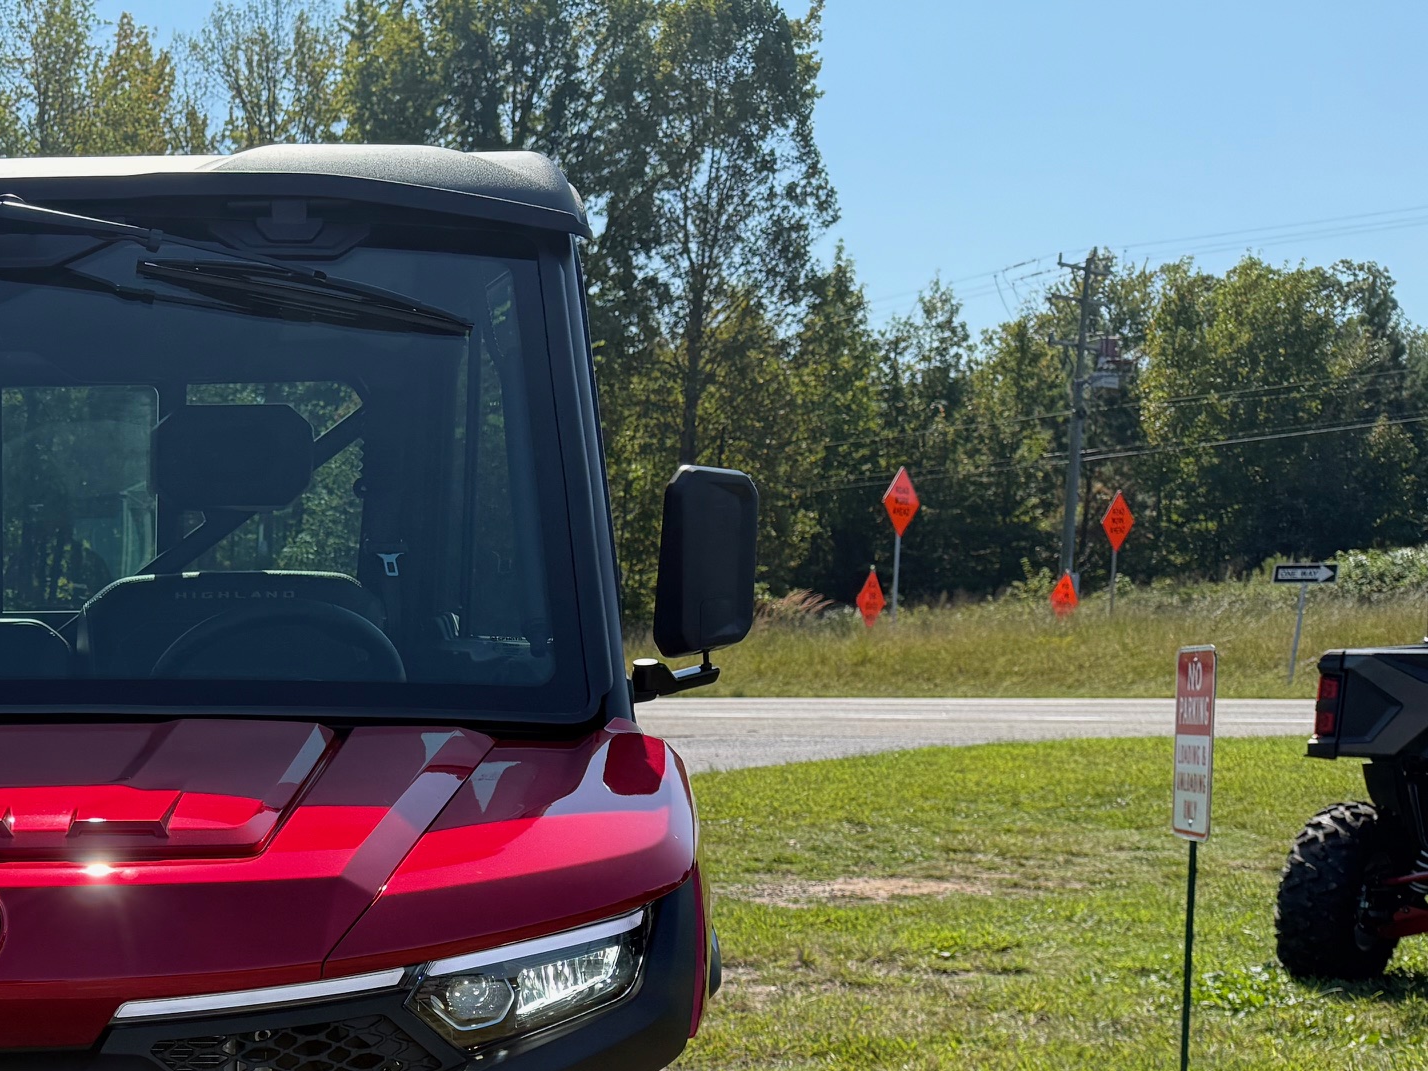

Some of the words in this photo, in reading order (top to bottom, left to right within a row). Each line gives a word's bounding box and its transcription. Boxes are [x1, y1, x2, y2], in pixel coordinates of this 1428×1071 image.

[1280, 569, 1297, 578] ONE
[1300, 569, 1319, 578] WAY
[175, 590, 295, 599] HIGHLAND
[1186, 661, 1203, 691] NO
[1178, 696, 1210, 726] PARKING
[1178, 745, 1200, 765] LOADING
[1177, 772, 1206, 794] UNLOADING
[1184, 800, 1197, 819] ONLY
